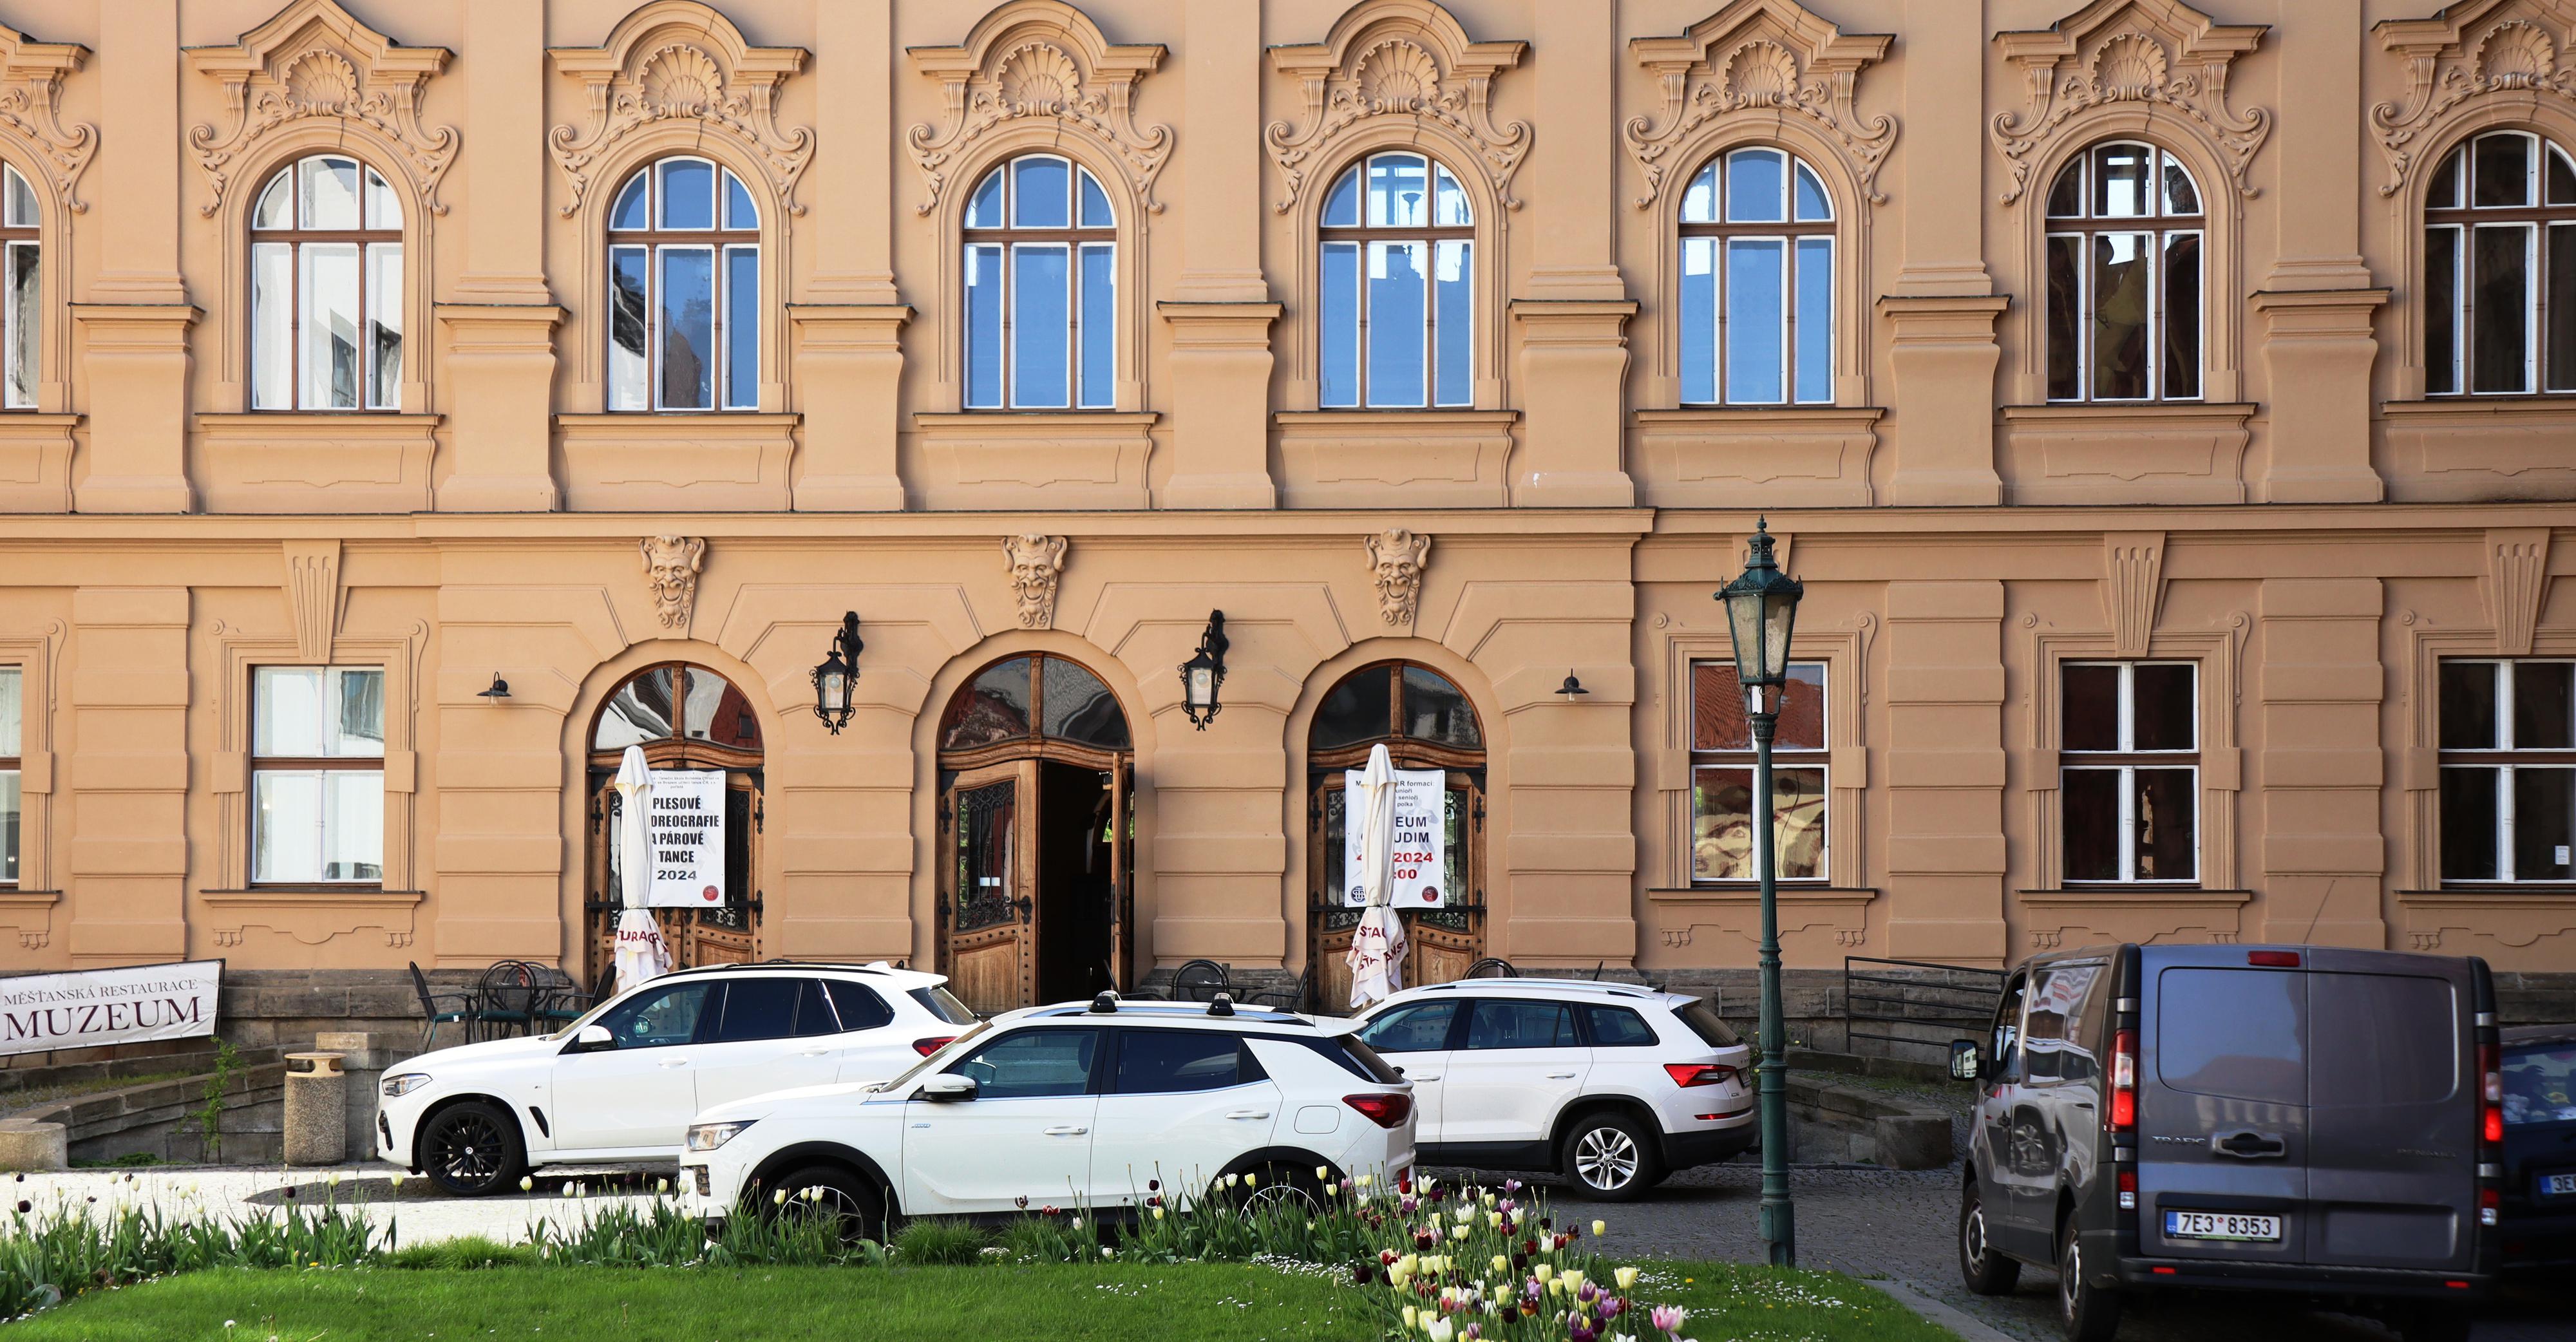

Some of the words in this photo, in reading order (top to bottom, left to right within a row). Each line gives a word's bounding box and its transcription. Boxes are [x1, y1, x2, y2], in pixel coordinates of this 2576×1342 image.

[653, 795, 701, 809] PLESOVÉ
[651, 815, 719, 827] OREOGRAFIE
[1396, 817, 1426, 827] EUM
[659, 831, 703, 845] PÁROVÉ
[1394, 832, 1429, 843] UDIM
[658, 851, 694, 862] TANCE
[1394, 853, 1434, 862] 2024
[657, 870, 697, 880] 2024
[1394, 869, 1417, 879] :00
[4, 985, 96, 1006] MĚŠŤANSKÁ
[100, 979, 199, 997] RESTAURACE
[3, 996, 202, 1041] MUZEUM
[2181, 1214, 2213, 1233] 7E3
[2228, 1216, 2271, 1236] 8353
